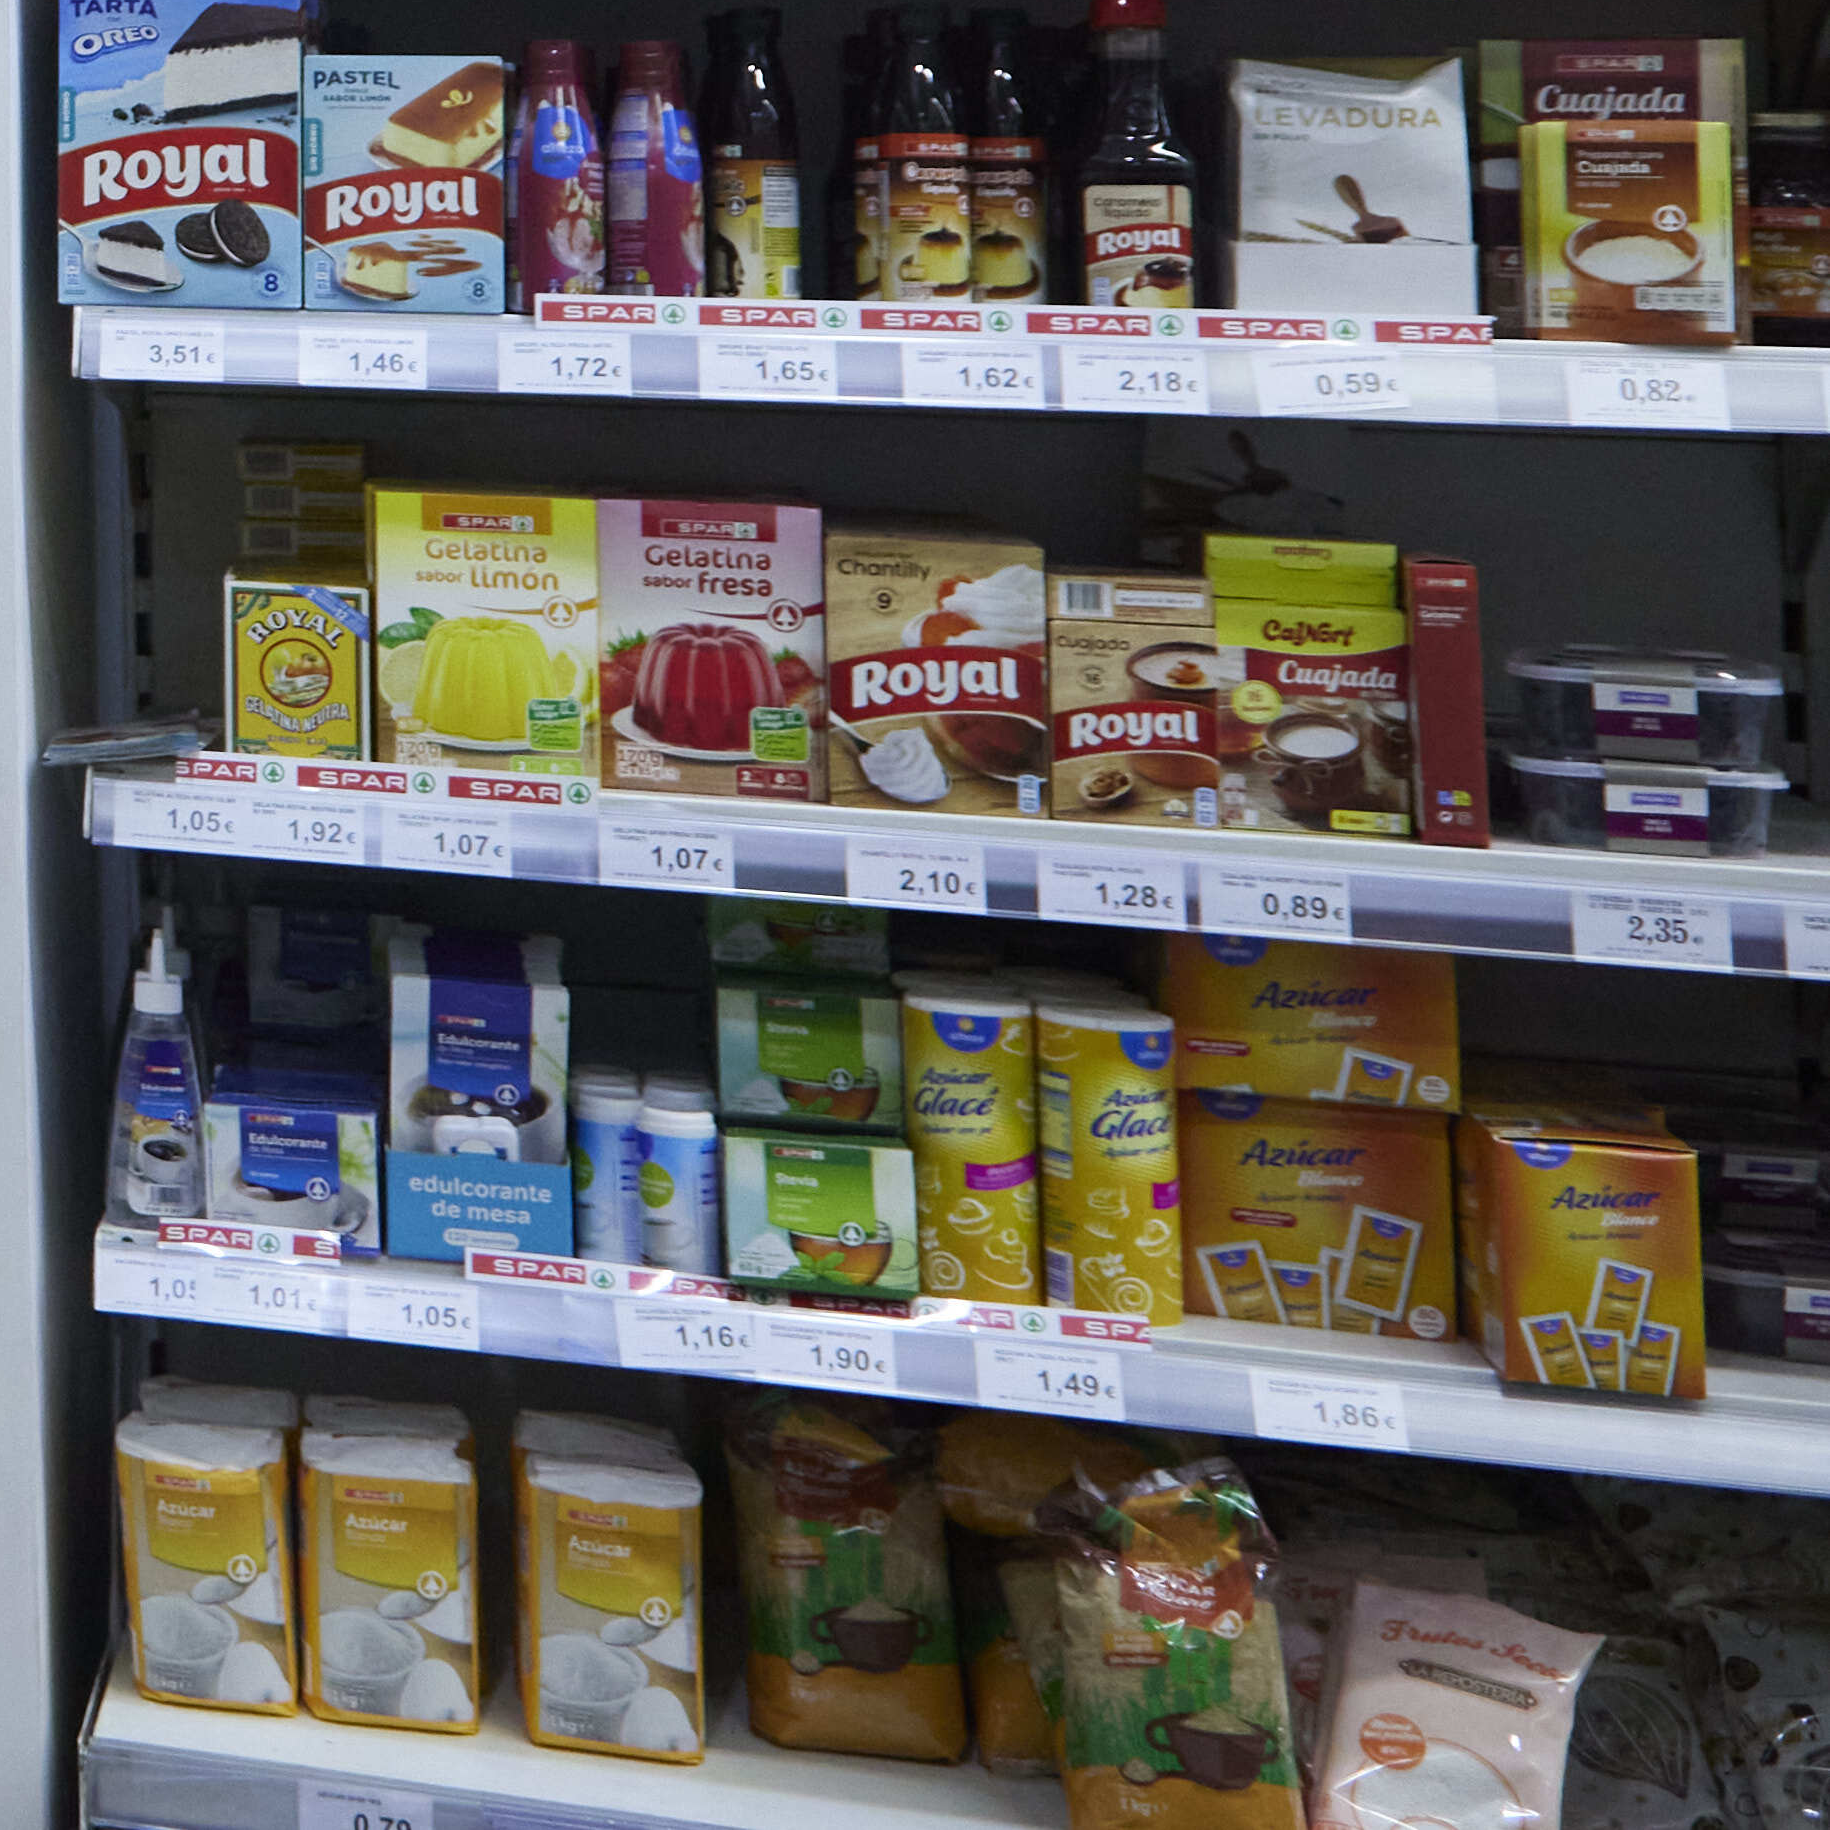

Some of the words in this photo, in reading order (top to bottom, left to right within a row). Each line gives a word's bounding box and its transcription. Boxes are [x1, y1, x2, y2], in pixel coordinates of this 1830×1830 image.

[72, 25, 159, 58] OREO
[313, 71, 401, 90] PASTEL
[1536, 84, 1686, 119] Cuajada
[1254, 107, 1442, 128] LEVADURA
[83, 139, 269, 207] Royal
[326, 177, 480, 231] Royal
[1097, 227, 1180, 256] Royal
[263, 275, 279, 292] 8
[472, 283, 485, 297] 8
[563, 306, 655, 321] SPAR
[721, 309, 815, 324] SPAR
[882, 312, 980, 330] SPAR
[1050, 317, 1149, 332] SPAR
[1222, 321, 1325, 338] SPAR
[457, 516, 511, 528] SPAR
[678, 522, 734, 535] SPAR
[424, 537, 548, 565] Gelatina
[644, 545, 773, 571] Gelatina
[415, 570, 463, 584] sabor
[470, 569, 560, 592] limón
[837, 557, 932, 581] Chantilly
[643, 575, 693, 589] sabor
[697, 571, 773, 597] fresa
[876, 592, 891, 610] 9
[246, 609, 344, 649] ROYAL
[1055, 636, 1130, 653] Cuajada
[852, 657, 1020, 708] Royal
[1277, 660, 1398, 694] Cuajada
[245, 696, 300, 732] GELATINA
[1069, 709, 1199, 748] Royal
[318, 771, 407, 790] SPAR
[469, 782, 560, 802] SPAR
[1251, 981, 1376, 1010] Azúcar
[436, 1033, 520, 1053] Edulcorante
[914, 1087, 999, 1116] Glacé
[248, 1133, 328, 1150] Edulcorante
[1241, 1139, 1366, 1167] Azúcar
[409, 1175, 553, 1204] edulcorante
[1551, 1186, 1661, 1210] Azúcar
[431, 1199, 458, 1218] de
[465, 1203, 531, 1225] mesa
[165, 1226, 252, 1245] SPAR
[492, 1258, 584, 1282] SPAR
[157, 1500, 217, 1521] Azúcar
[345, 1513, 409, 1534] Azúcar
[569, 1534, 632, 1559] Azúcar
